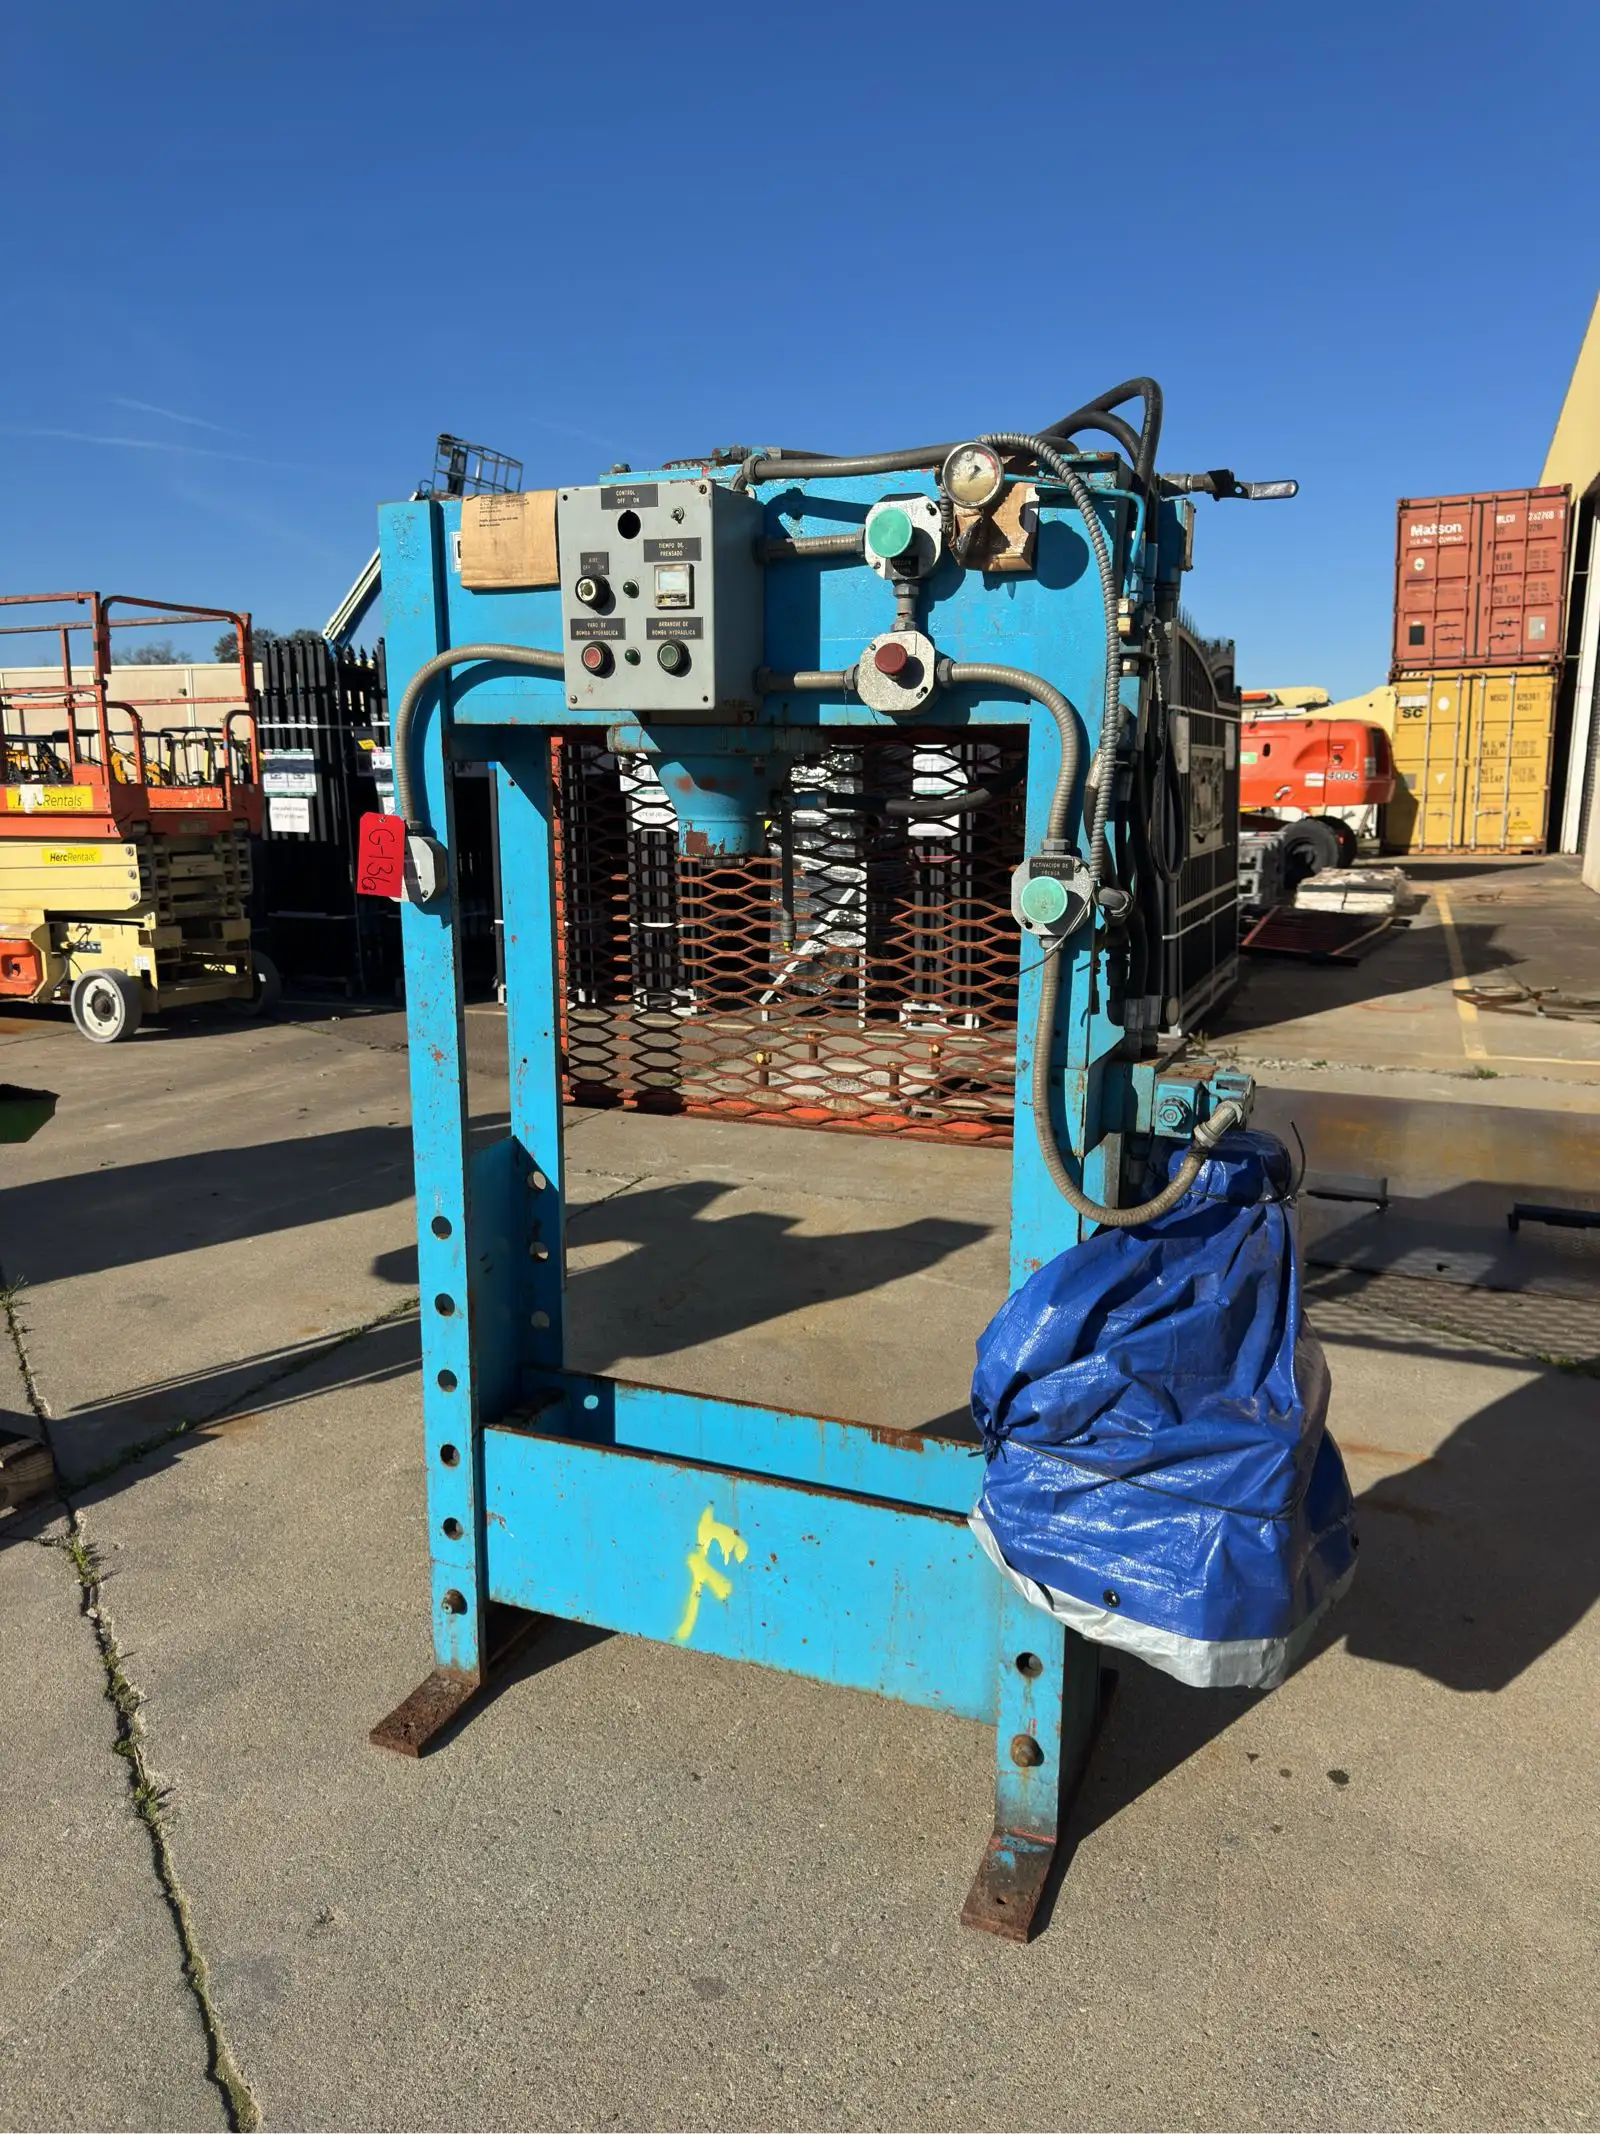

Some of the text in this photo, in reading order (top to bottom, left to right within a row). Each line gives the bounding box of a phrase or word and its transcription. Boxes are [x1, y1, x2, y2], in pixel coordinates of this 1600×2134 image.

[615, 489, 636, 497] CONTROL
[1410, 523, 1462, 537] Matson
[1327, 771, 1359, 781] 400S
[50, 853, 95, 862] HercRentals
[361, 828, 395, 890] G-136
